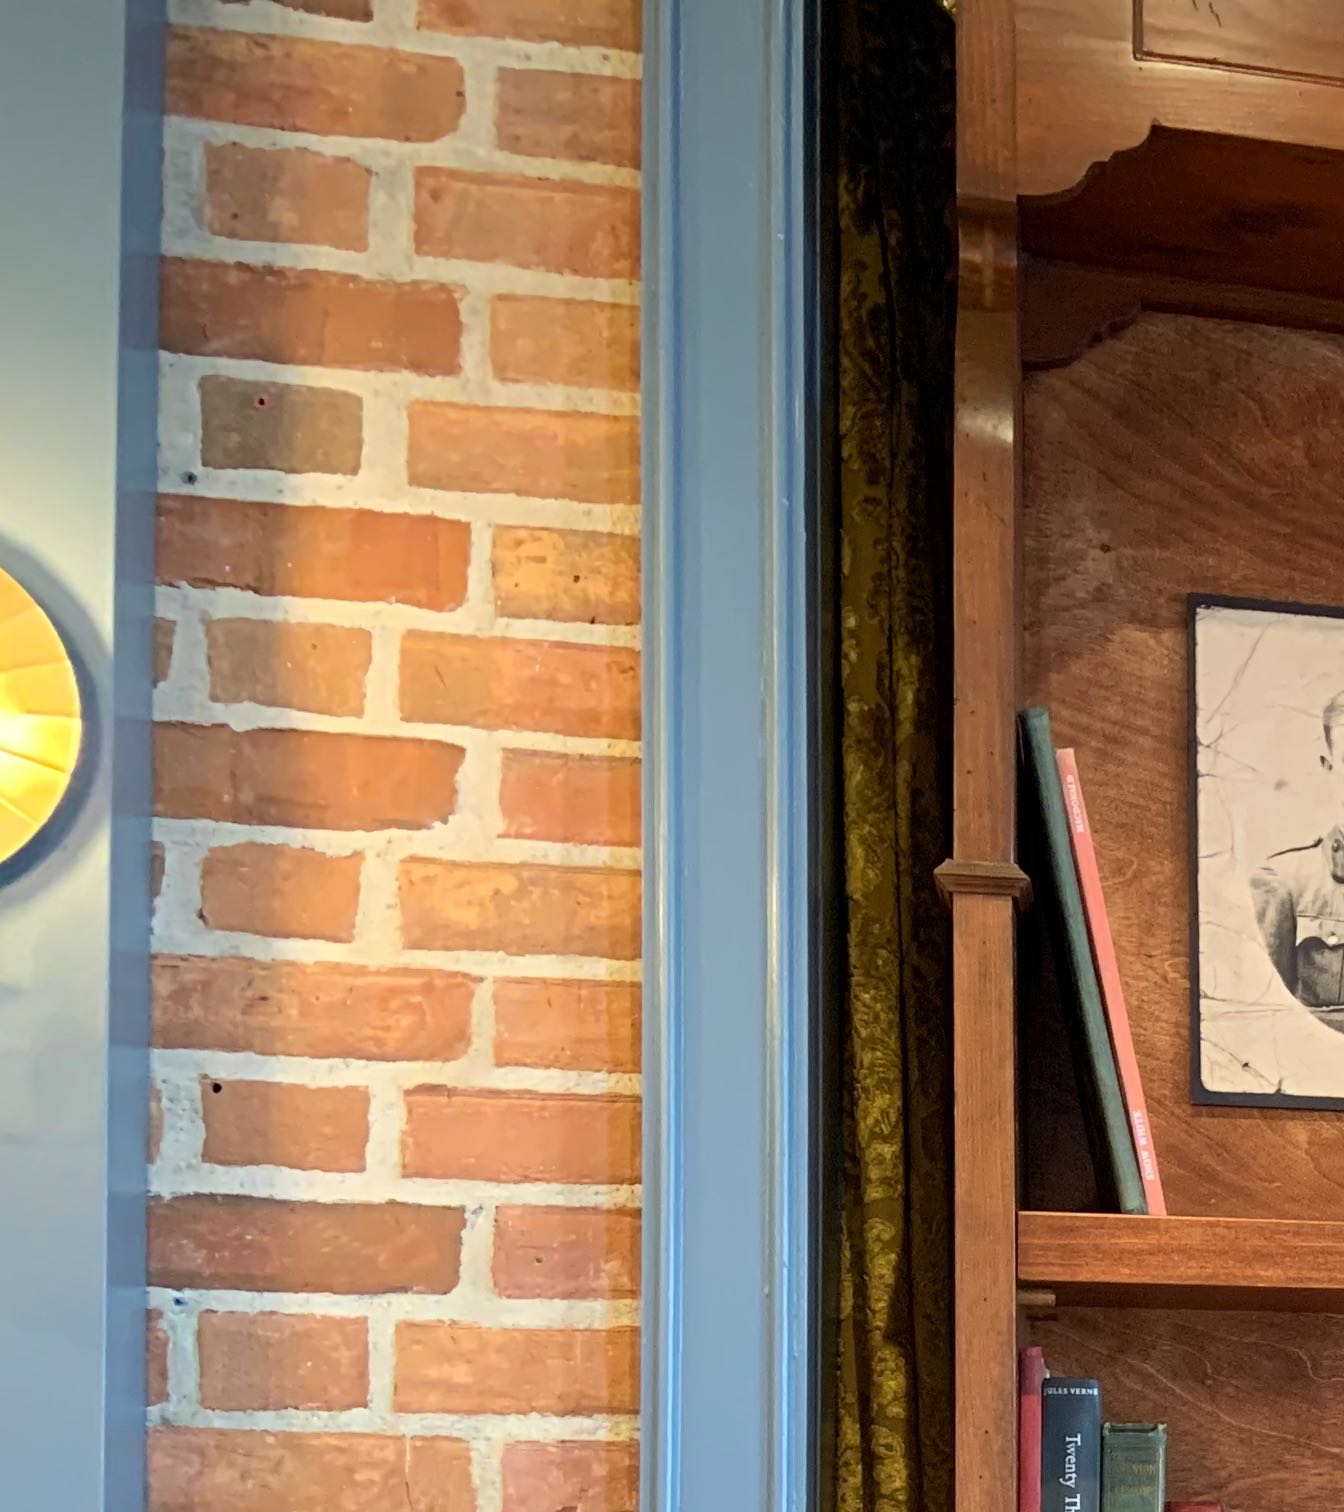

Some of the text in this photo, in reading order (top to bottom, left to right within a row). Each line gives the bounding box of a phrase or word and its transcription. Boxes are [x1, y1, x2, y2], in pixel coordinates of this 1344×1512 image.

[1043, 1386, 1099, 1397] JULES VERNE
[1059, 1432, 1082, 1489] Twenty
